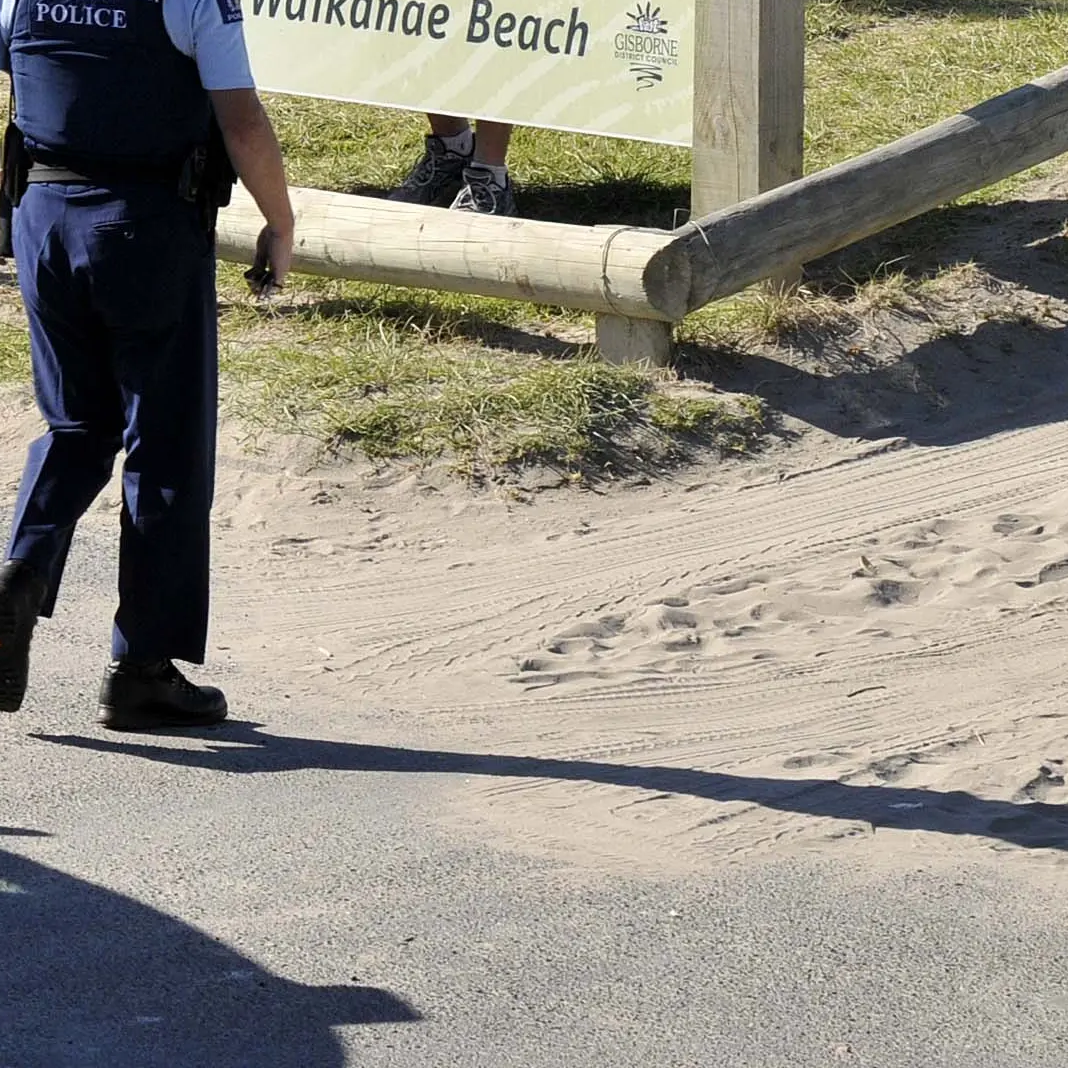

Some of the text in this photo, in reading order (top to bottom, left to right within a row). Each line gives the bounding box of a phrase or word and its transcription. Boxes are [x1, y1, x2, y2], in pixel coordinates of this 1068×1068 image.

[36, 2, 127, 28] POLICE
[614, 33, 678, 57] GISBORNE
[614, 51, 678, 65] DISTRICT COUNCIL
